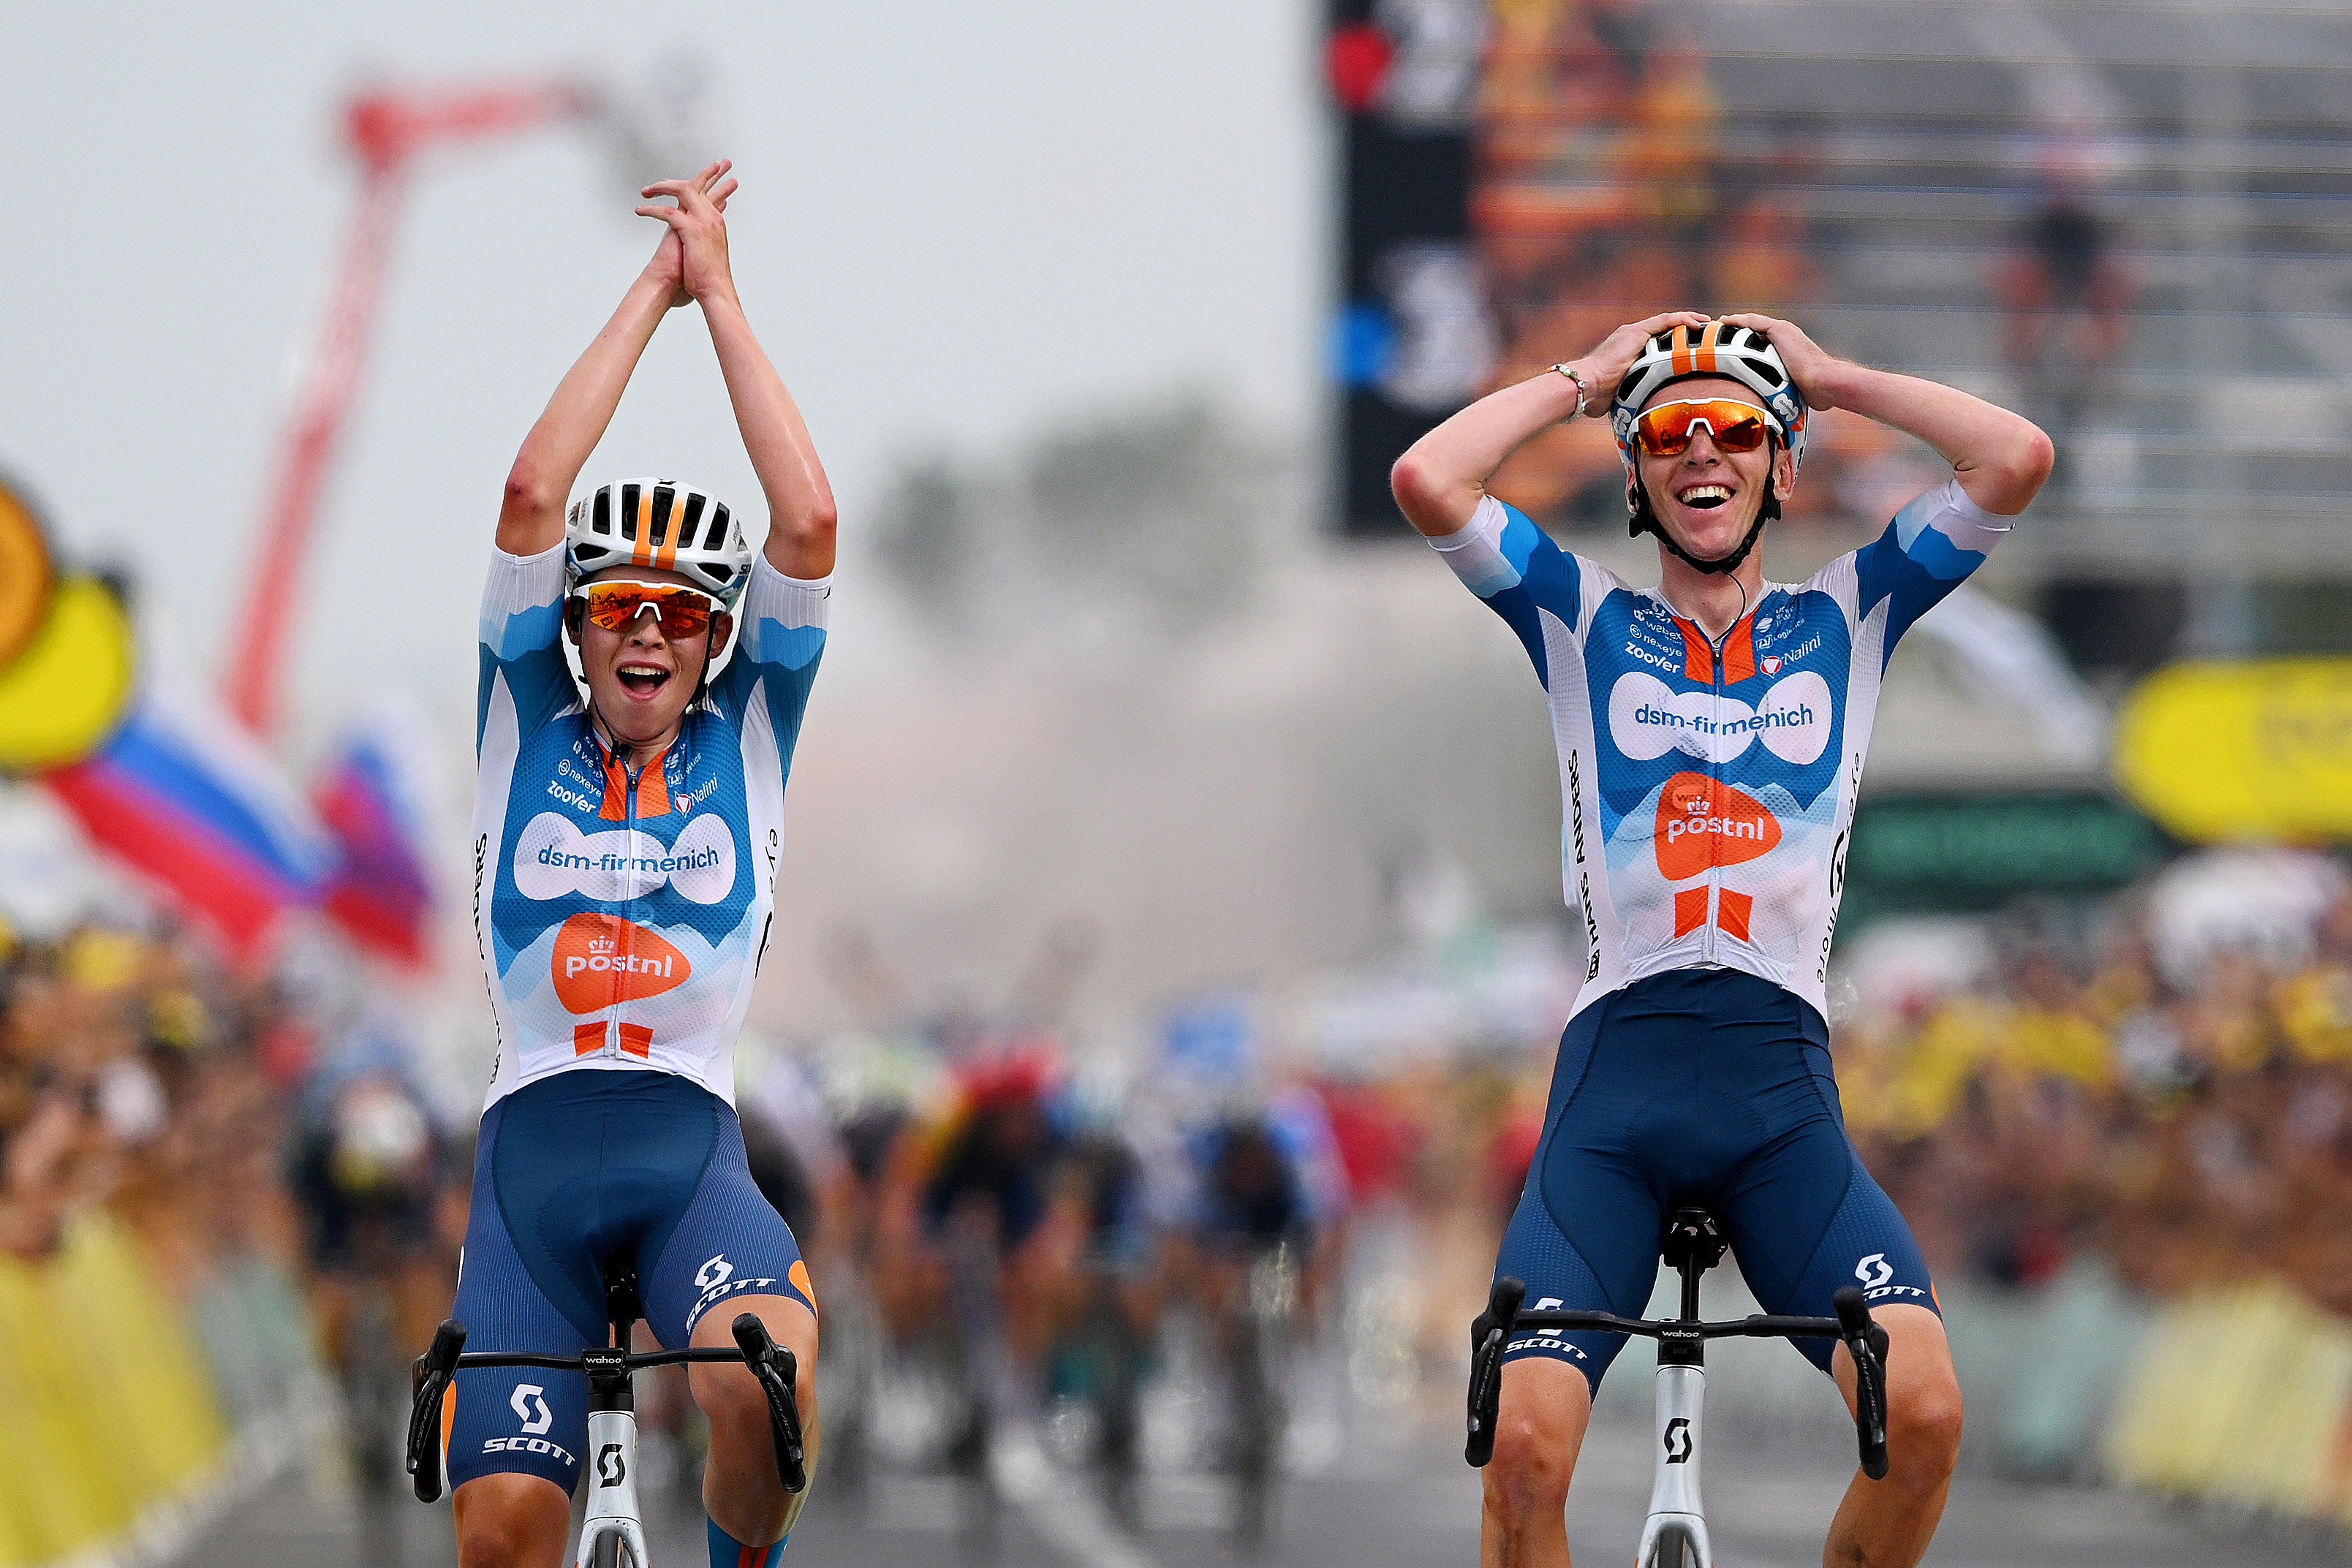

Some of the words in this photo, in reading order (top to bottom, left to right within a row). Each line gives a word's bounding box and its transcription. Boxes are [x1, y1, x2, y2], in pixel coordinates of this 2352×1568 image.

[1625, 641, 1681, 673] zoover
[1644, 635, 1682, 657] nexeye
[1784, 631, 1820, 665] Nalini
[1635, 703, 1813, 735] dsm-firmenich
[547, 780, 597, 813] zoover
[570, 770, 602, 798] nexeye
[691, 772, 718, 806] Nalini
[1568, 749, 1586, 865] ANDERS
[1668, 817, 1764, 844] postnl
[537, 844, 719, 874] dsm-firmenich
[1580, 871, 1600, 947] HANS
[566, 953, 673, 978] postnl
[686, 1278, 777, 1335] SCOTT
[1863, 1287, 1926, 1301] OTT
[1504, 1338, 1588, 1360] SCOTT
[1662, 1330, 1700, 1338] wahoo
[586, 1355, 621, 1364] wahoo
[482, 1436, 576, 1466] SCOTT
